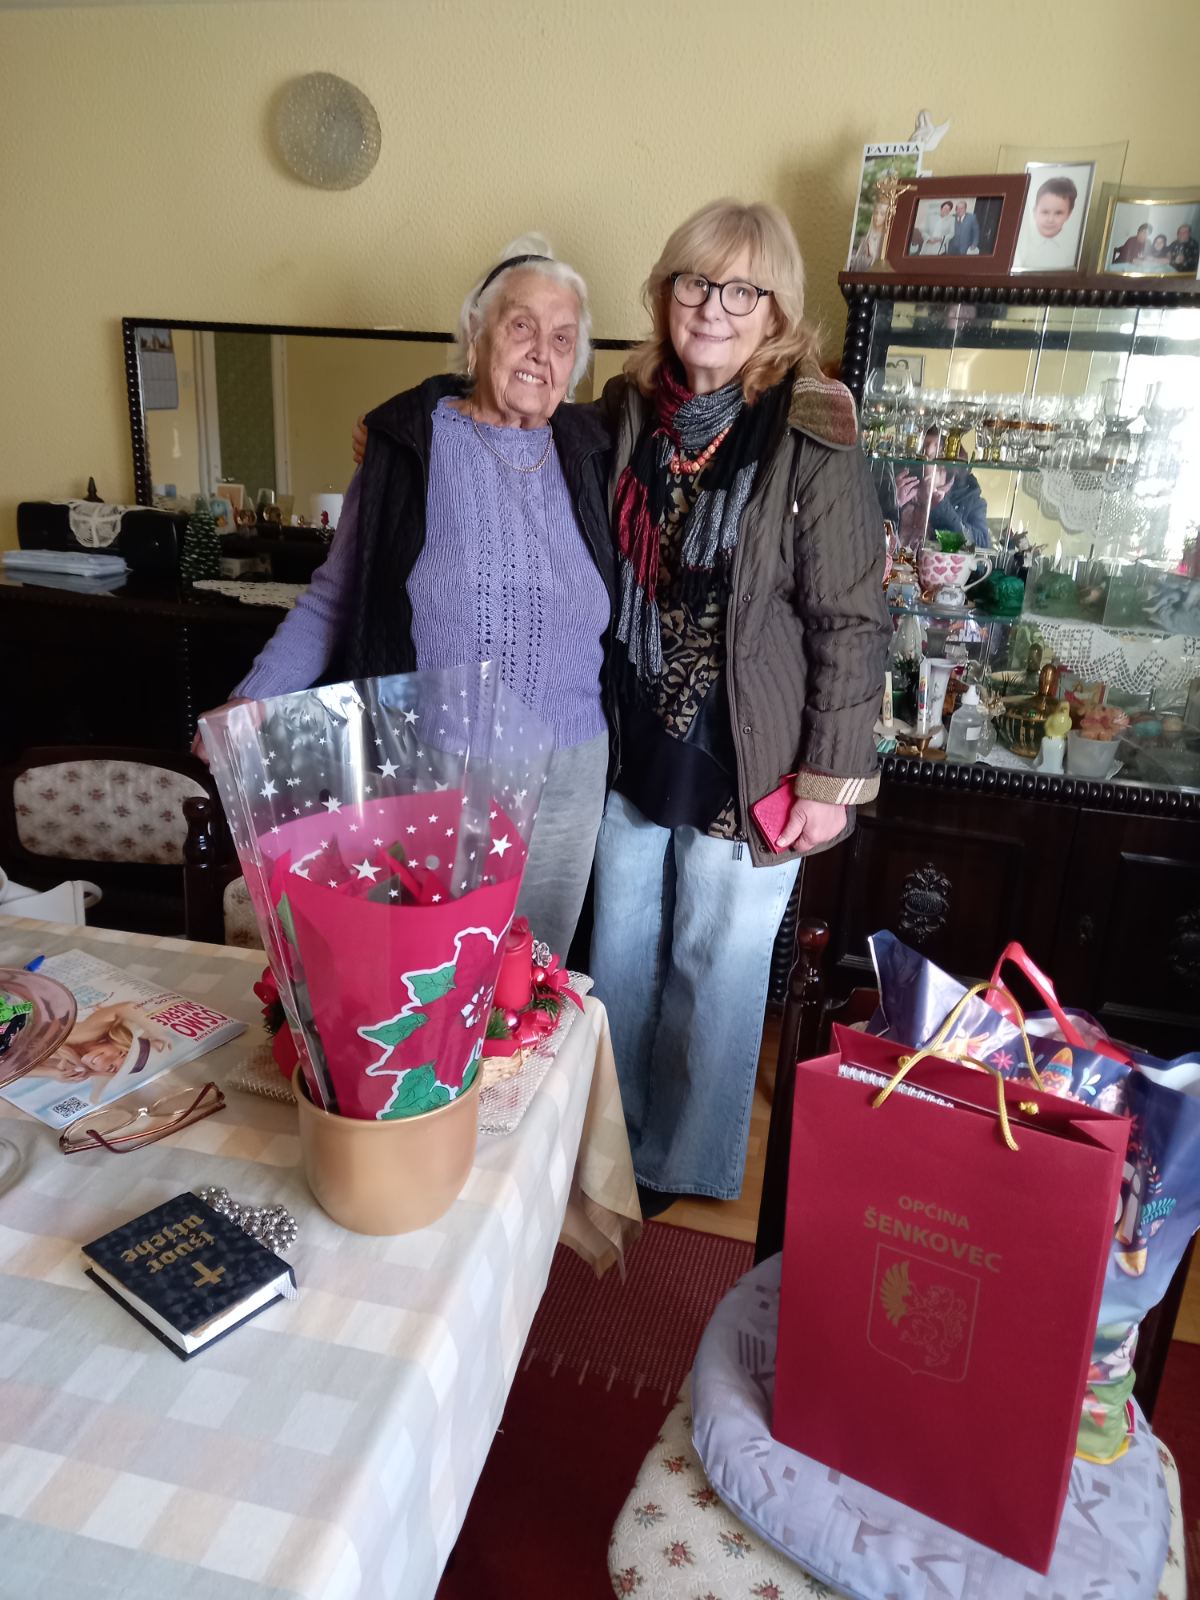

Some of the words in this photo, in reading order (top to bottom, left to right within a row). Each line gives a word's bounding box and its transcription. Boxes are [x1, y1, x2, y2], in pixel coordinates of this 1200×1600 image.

[866, 144, 919, 154] FATIMA
[150, 1001, 204, 1026] SMJERKE
[170, 1009, 228, 1038] OSMO
[898, 1195, 970, 1232] OPĆINA
[121, 1215, 204, 1262] utjehe
[864, 1206, 1002, 1273] ŠENKOVEC
